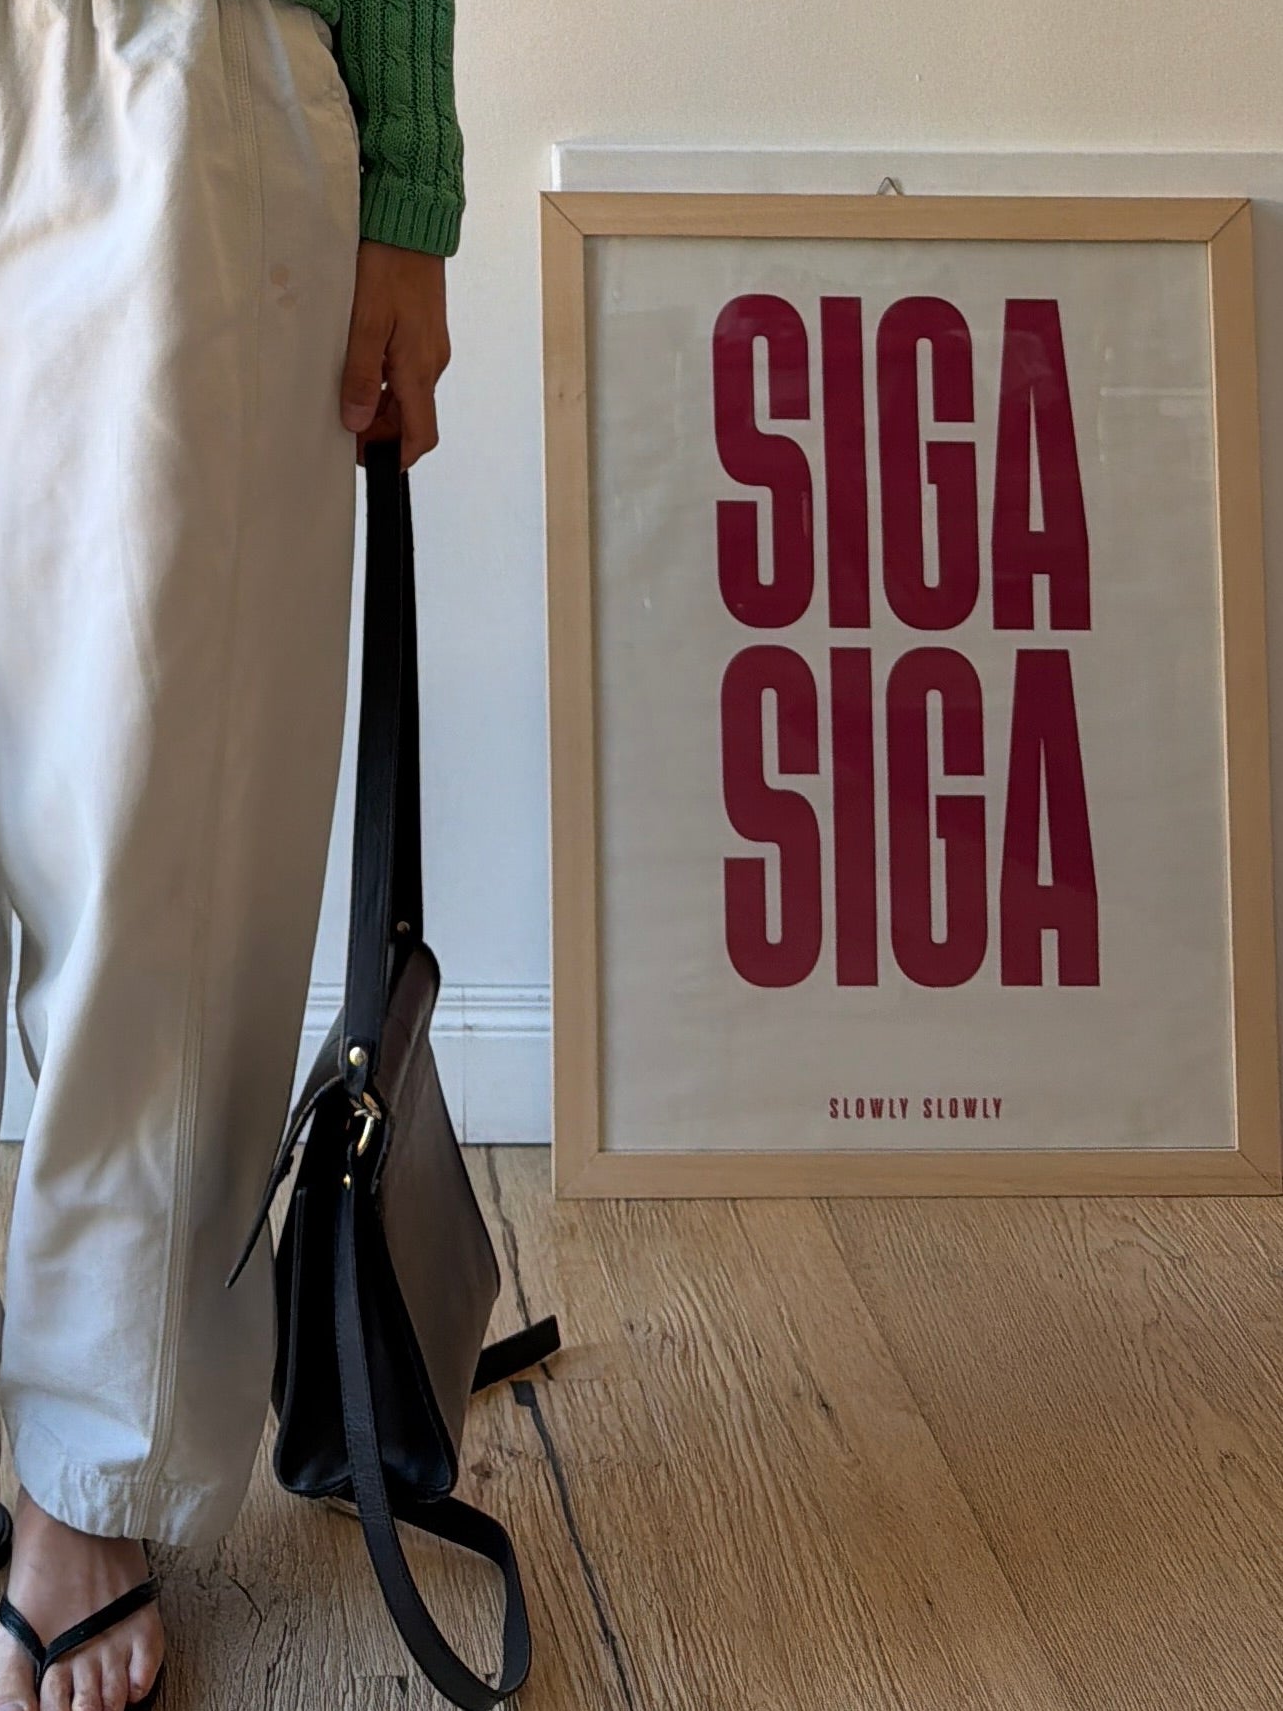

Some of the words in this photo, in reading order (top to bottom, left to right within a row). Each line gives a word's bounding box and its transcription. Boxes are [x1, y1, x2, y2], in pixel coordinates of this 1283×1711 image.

[712, 293, 1091, 631] SIGA
[720, 645, 1100, 988] SIGA
[829, 1097, 908, 1119] SLOWLY
[923, 1097, 1002, 1119] SLOWLY
